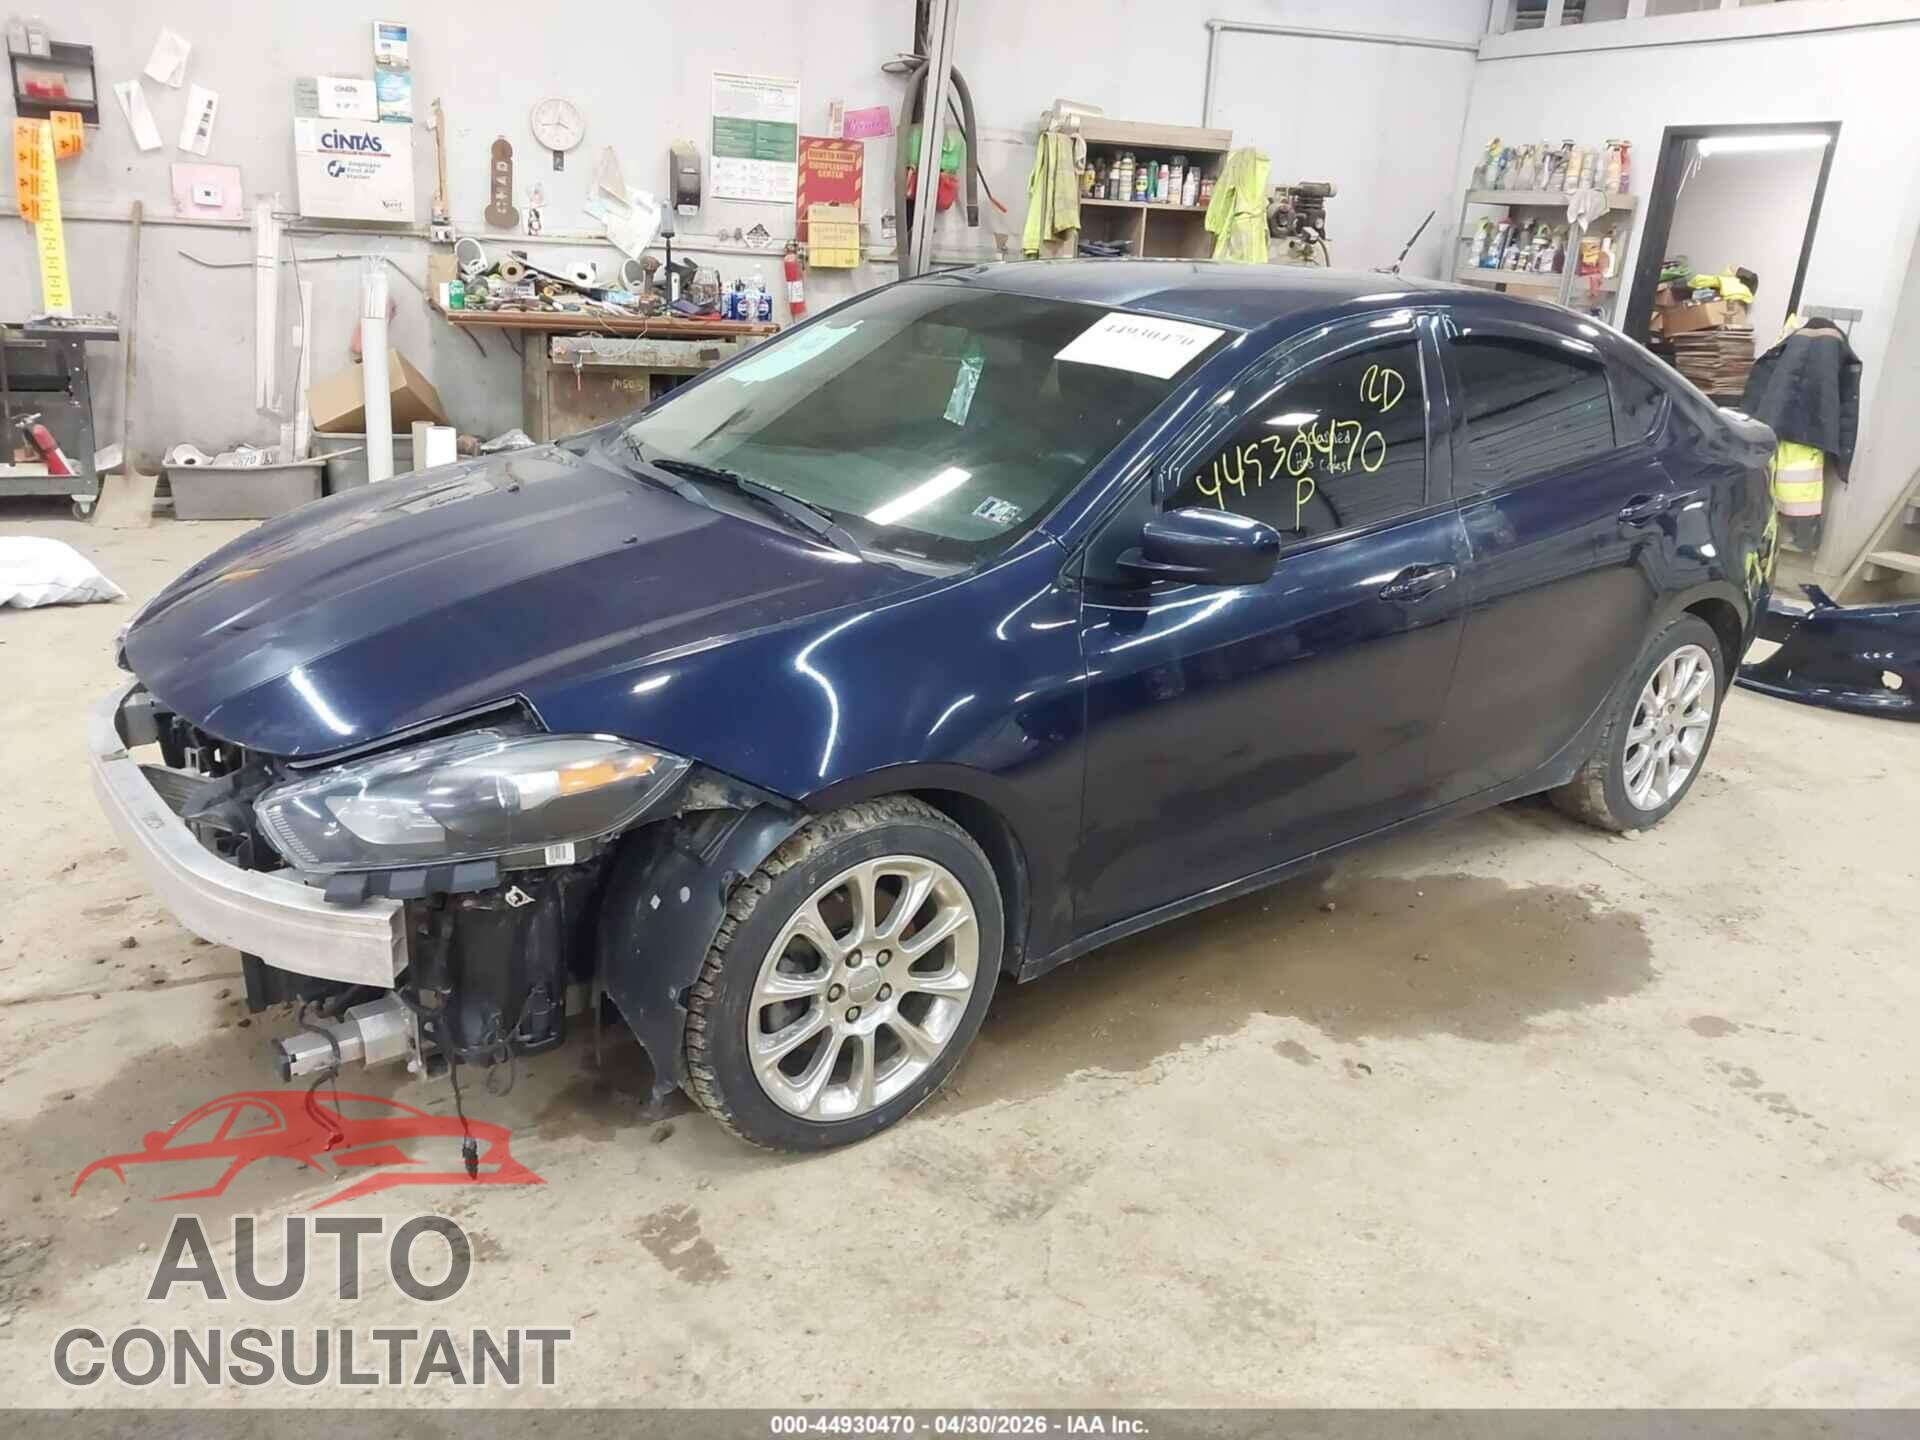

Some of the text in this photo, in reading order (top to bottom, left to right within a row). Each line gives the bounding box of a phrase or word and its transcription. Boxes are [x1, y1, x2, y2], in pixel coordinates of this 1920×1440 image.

[321, 129, 383, 152] CINTAS
[1196, 419, 1386, 511] 44930470
[1296, 477, 1315, 531] P
